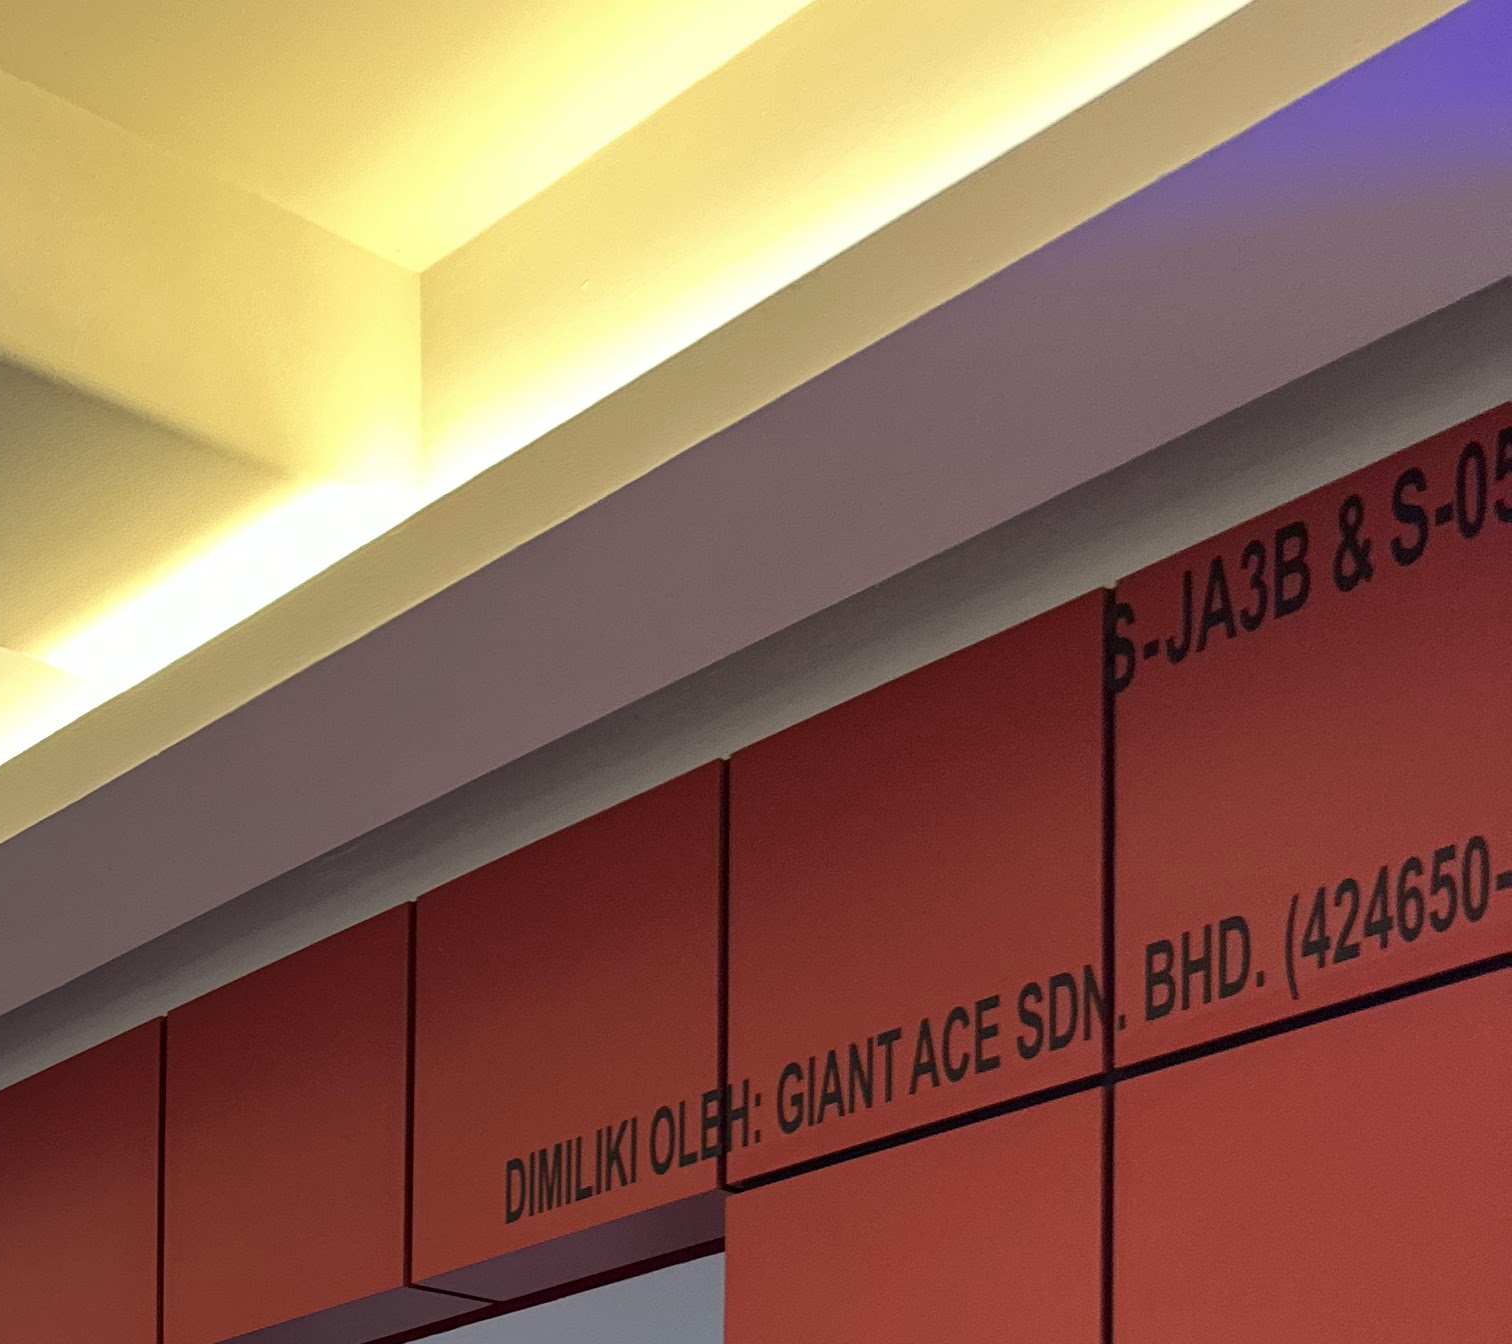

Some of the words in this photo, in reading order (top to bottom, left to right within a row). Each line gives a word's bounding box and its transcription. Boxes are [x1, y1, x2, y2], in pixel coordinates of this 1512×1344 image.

[1104, 520, 1312, 695] S-JA3B
[1332, 493, 1374, 593] &
[504, 1116, 639, 1225] DIMILIKI
[649, 1078, 763, 1176] OLEH:
[776, 1027, 903, 1135] GIANT
[908, 994, 1002, 1096] ACE
[1016, 962, 1127, 1060] SDN.
[1145, 914, 1266, 1022] BHD.
